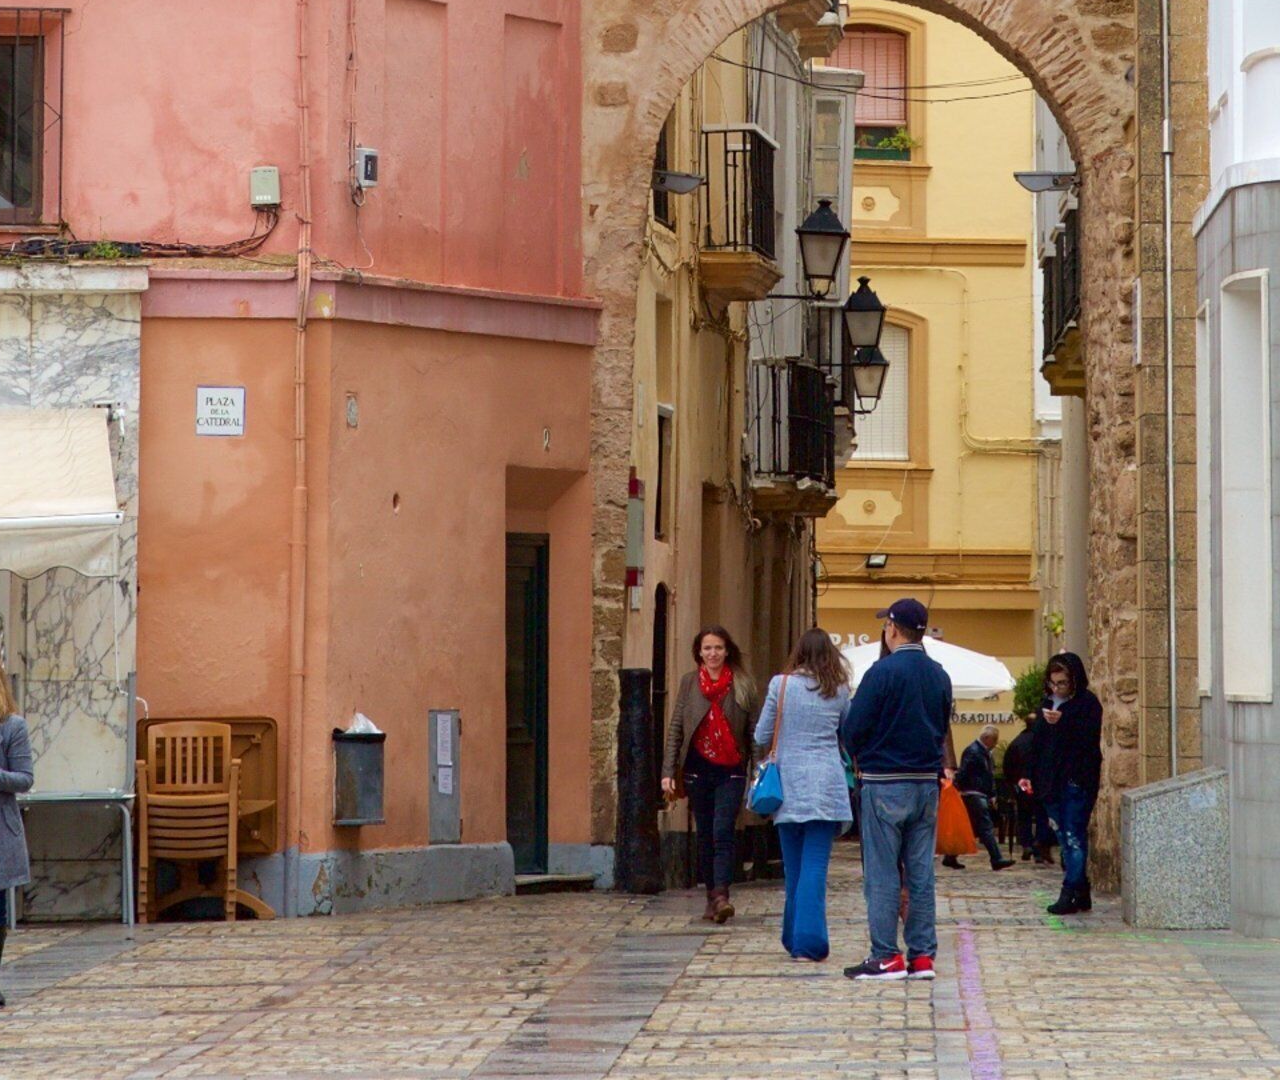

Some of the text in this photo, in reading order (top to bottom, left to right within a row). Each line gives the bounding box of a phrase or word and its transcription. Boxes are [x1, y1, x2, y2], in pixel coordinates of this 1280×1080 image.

[205, 397, 235, 407] PLAZA
[210, 408, 230, 416] DE LA
[197, 417, 243, 427] CATEDRAL
[950, 712, 1015, 725] OSADILLA
